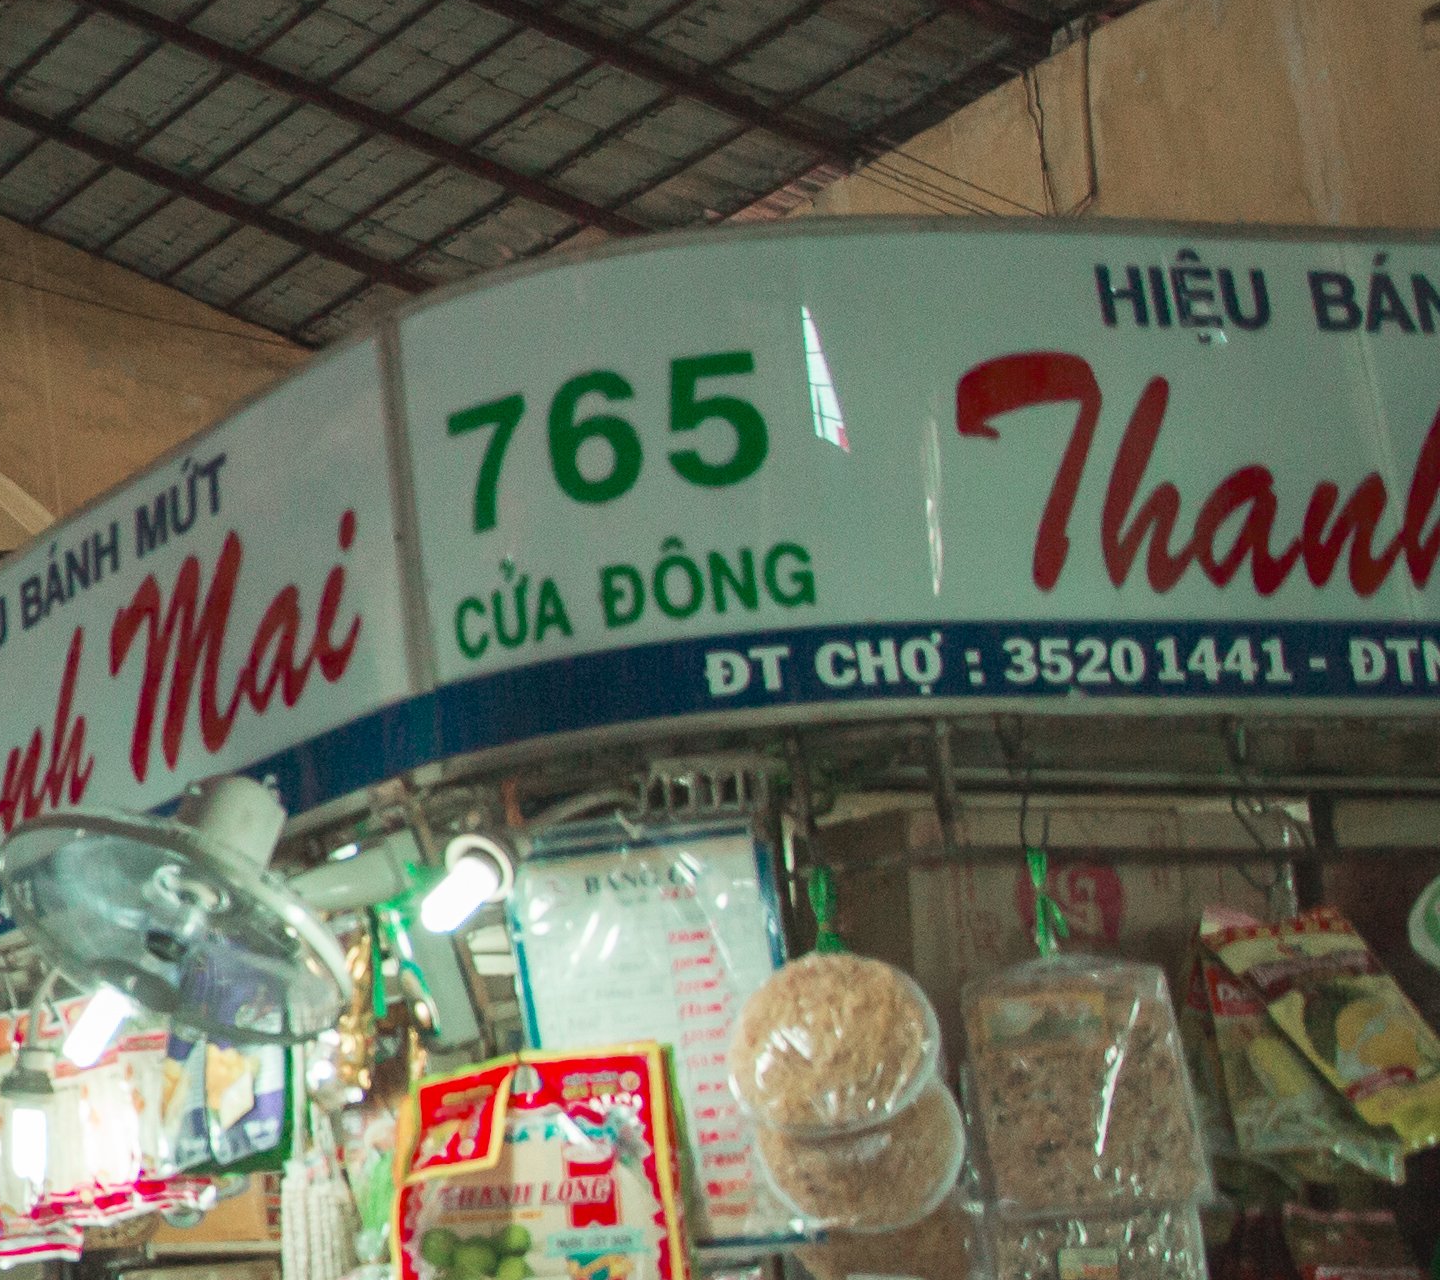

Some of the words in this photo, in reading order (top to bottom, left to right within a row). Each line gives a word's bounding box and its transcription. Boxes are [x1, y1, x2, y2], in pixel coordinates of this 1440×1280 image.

[1095, 249, 1270, 344] HIỆU
[447, 350, 769, 534] 765
[20, 533, 121, 632] BÁNH
[135, 453, 228, 558] MỨT
[454, 555, 573, 660] CỬA
[600, 536, 816, 628] ĐÔNG
[110, 509, 363, 783] Mai
[704, 646, 790, 698] ĐT
[814, 632, 943, 696] CHỢ
[540, 1176, 611, 1205] LONG
